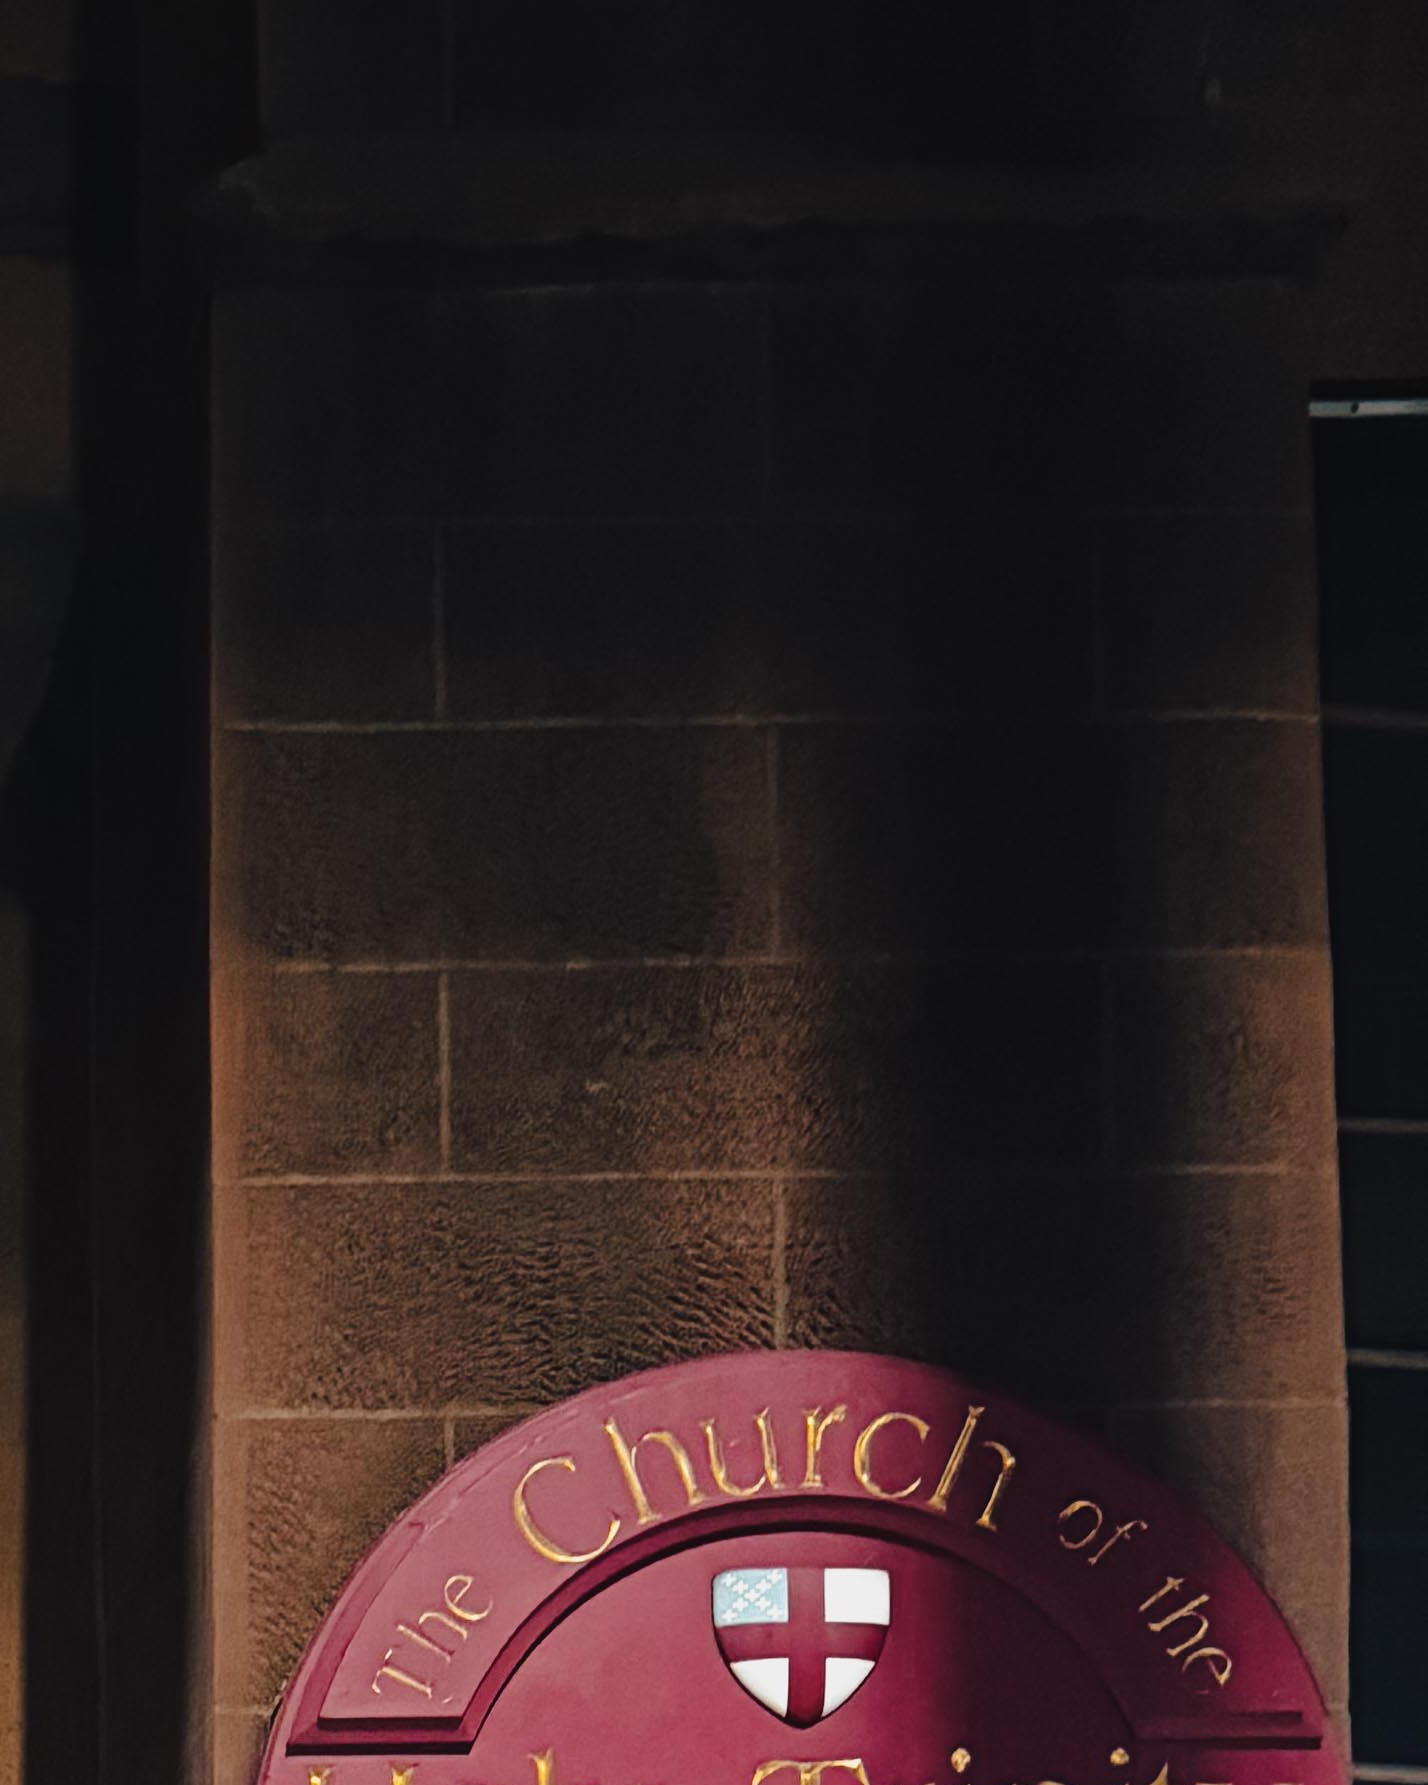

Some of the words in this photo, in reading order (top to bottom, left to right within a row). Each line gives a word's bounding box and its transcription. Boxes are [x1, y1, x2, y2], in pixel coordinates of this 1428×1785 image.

[373, 1574, 494, 1700] The
[512, 1404, 1018, 1564] Church
[1057, 1499, 1148, 1565] of
[1138, 1577, 1235, 1688] the
